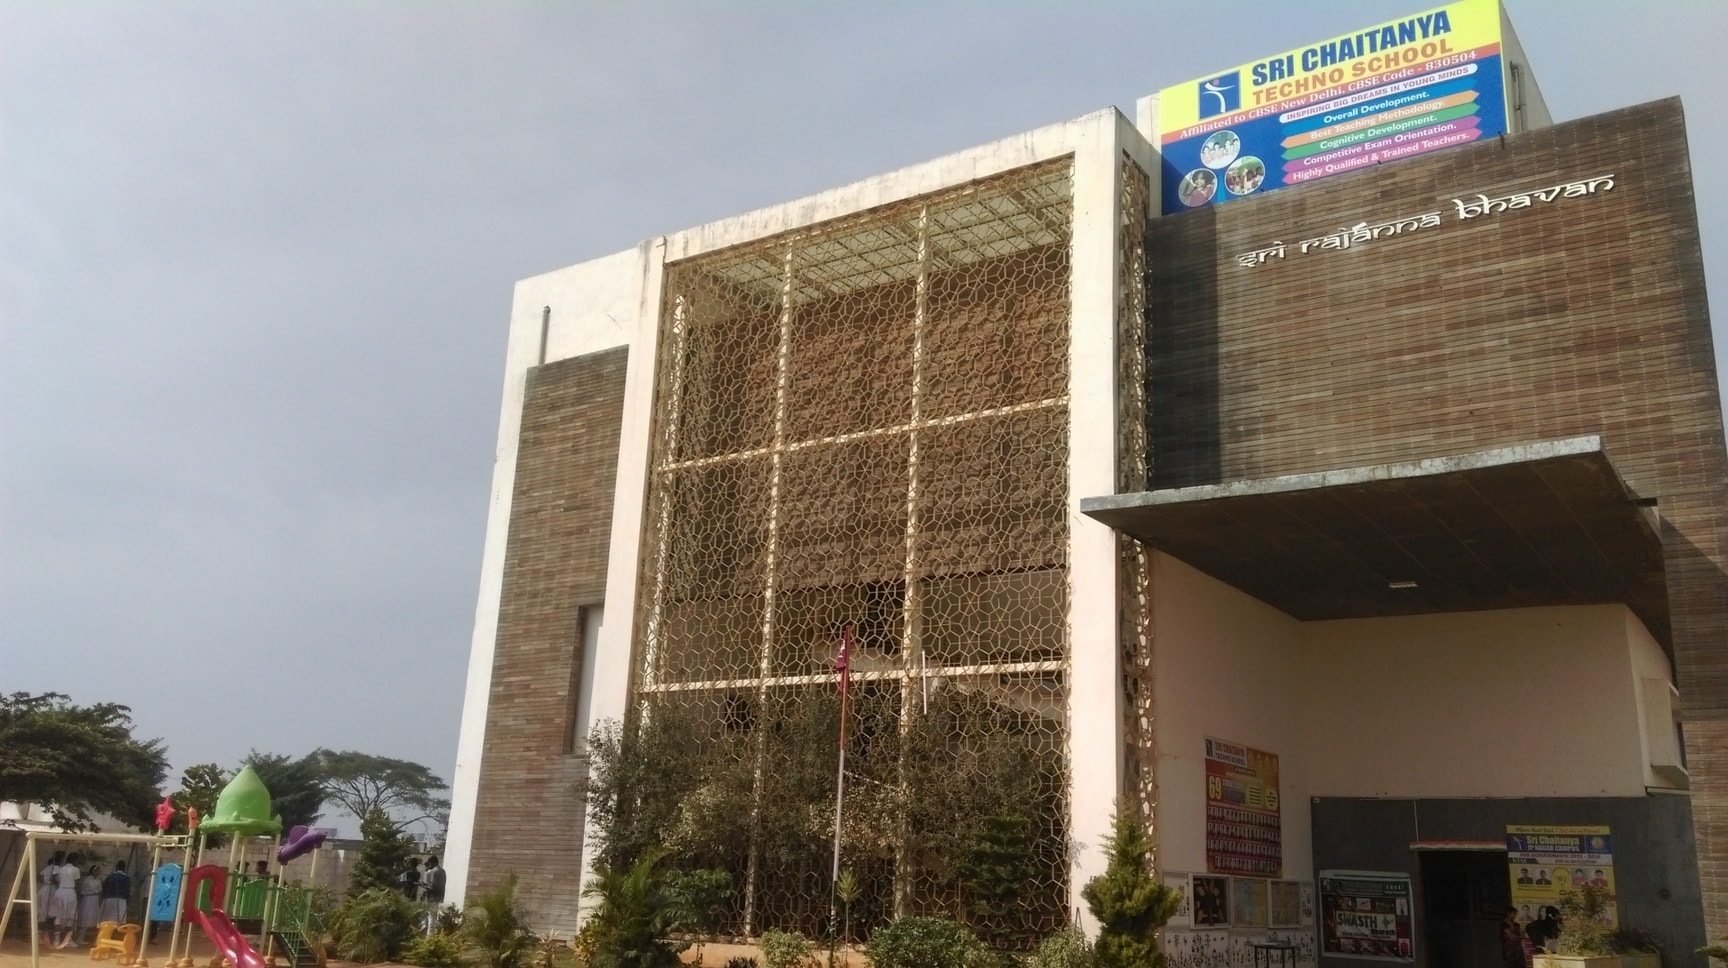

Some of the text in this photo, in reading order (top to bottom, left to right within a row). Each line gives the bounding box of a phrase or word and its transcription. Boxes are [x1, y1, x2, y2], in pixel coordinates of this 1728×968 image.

[1252, 10, 1451, 86] SRI CHAITANYA
[1253, 39, 1453, 105] TECHNO SCHOOL
[1180, 119, 1232, 138] Affiliated
[1234, 114, 1245, 122] to
[1249, 105, 1278, 118] CBSE
[1281, 97, 1307, 109] New
[1348, 75, 1380, 91] CBSE
[1383, 67, 1414, 82] Code
[1425, 50, 1477, 70] 830504
[1287, 104, 1331, 120] INSPIRING
[1334, 99, 1348, 108] BIG
[1351, 88, 1388, 103] DREAMS
[1403, 75, 1435, 89] YOUNG
[1438, 67, 1469, 80] MINDS
[1324, 92, 1430, 123] Overall Development.
[1311, 100, 1445, 139] Best Teaching Methodology.
[1320, 115, 1437, 149] Cognitive Development.
[1293, 167, 1323, 181] Highly
[1326, 155, 1368, 172] Qualified
[1382, 144, 1419, 158] Trained
[1422, 133, 1470, 149] Teachers.
[1304, 123, 1456, 165] Competitive Exam Orientation.
[1237, 241, 1287, 268] sri
[1454, 174, 1615, 220] bhavan
[1209, 776, 1221, 800] 69
[1526, 836, 1579, 846] Sri Chaitanya
[1337, 912, 1377, 928] SWASTH
